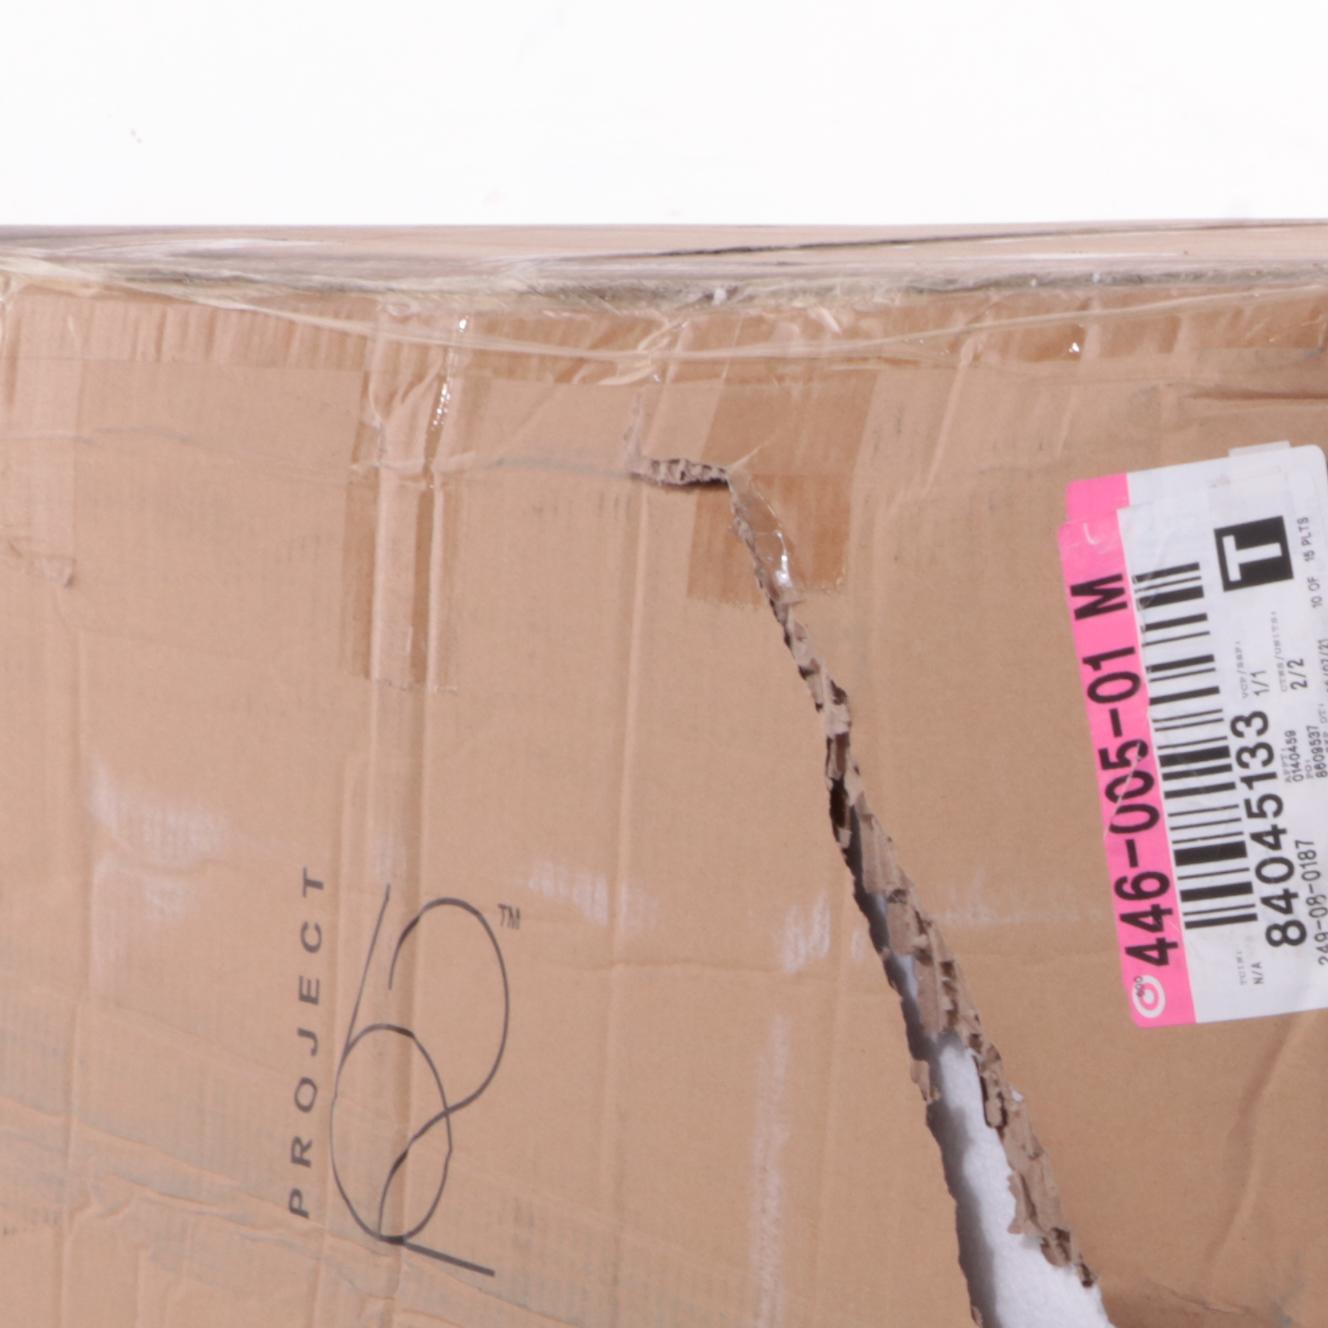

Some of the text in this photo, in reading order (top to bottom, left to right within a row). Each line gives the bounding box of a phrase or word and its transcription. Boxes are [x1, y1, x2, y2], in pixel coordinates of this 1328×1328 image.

[1296, 516, 1312, 547] PLTS
[1306, 576, 1320, 592] OF
[1310, 595, 1323, 609] 10
[1249, 670, 1269, 696] 1/1
[1286, 658, 1308, 690] 2/2
[1070, 573, 1179, 967] 446-005-01 M
[1229, 710, 1308, 948] 84045133
[1251, 962, 1263, 985] N/A
[288, 866, 325, 1219] PROJECT
